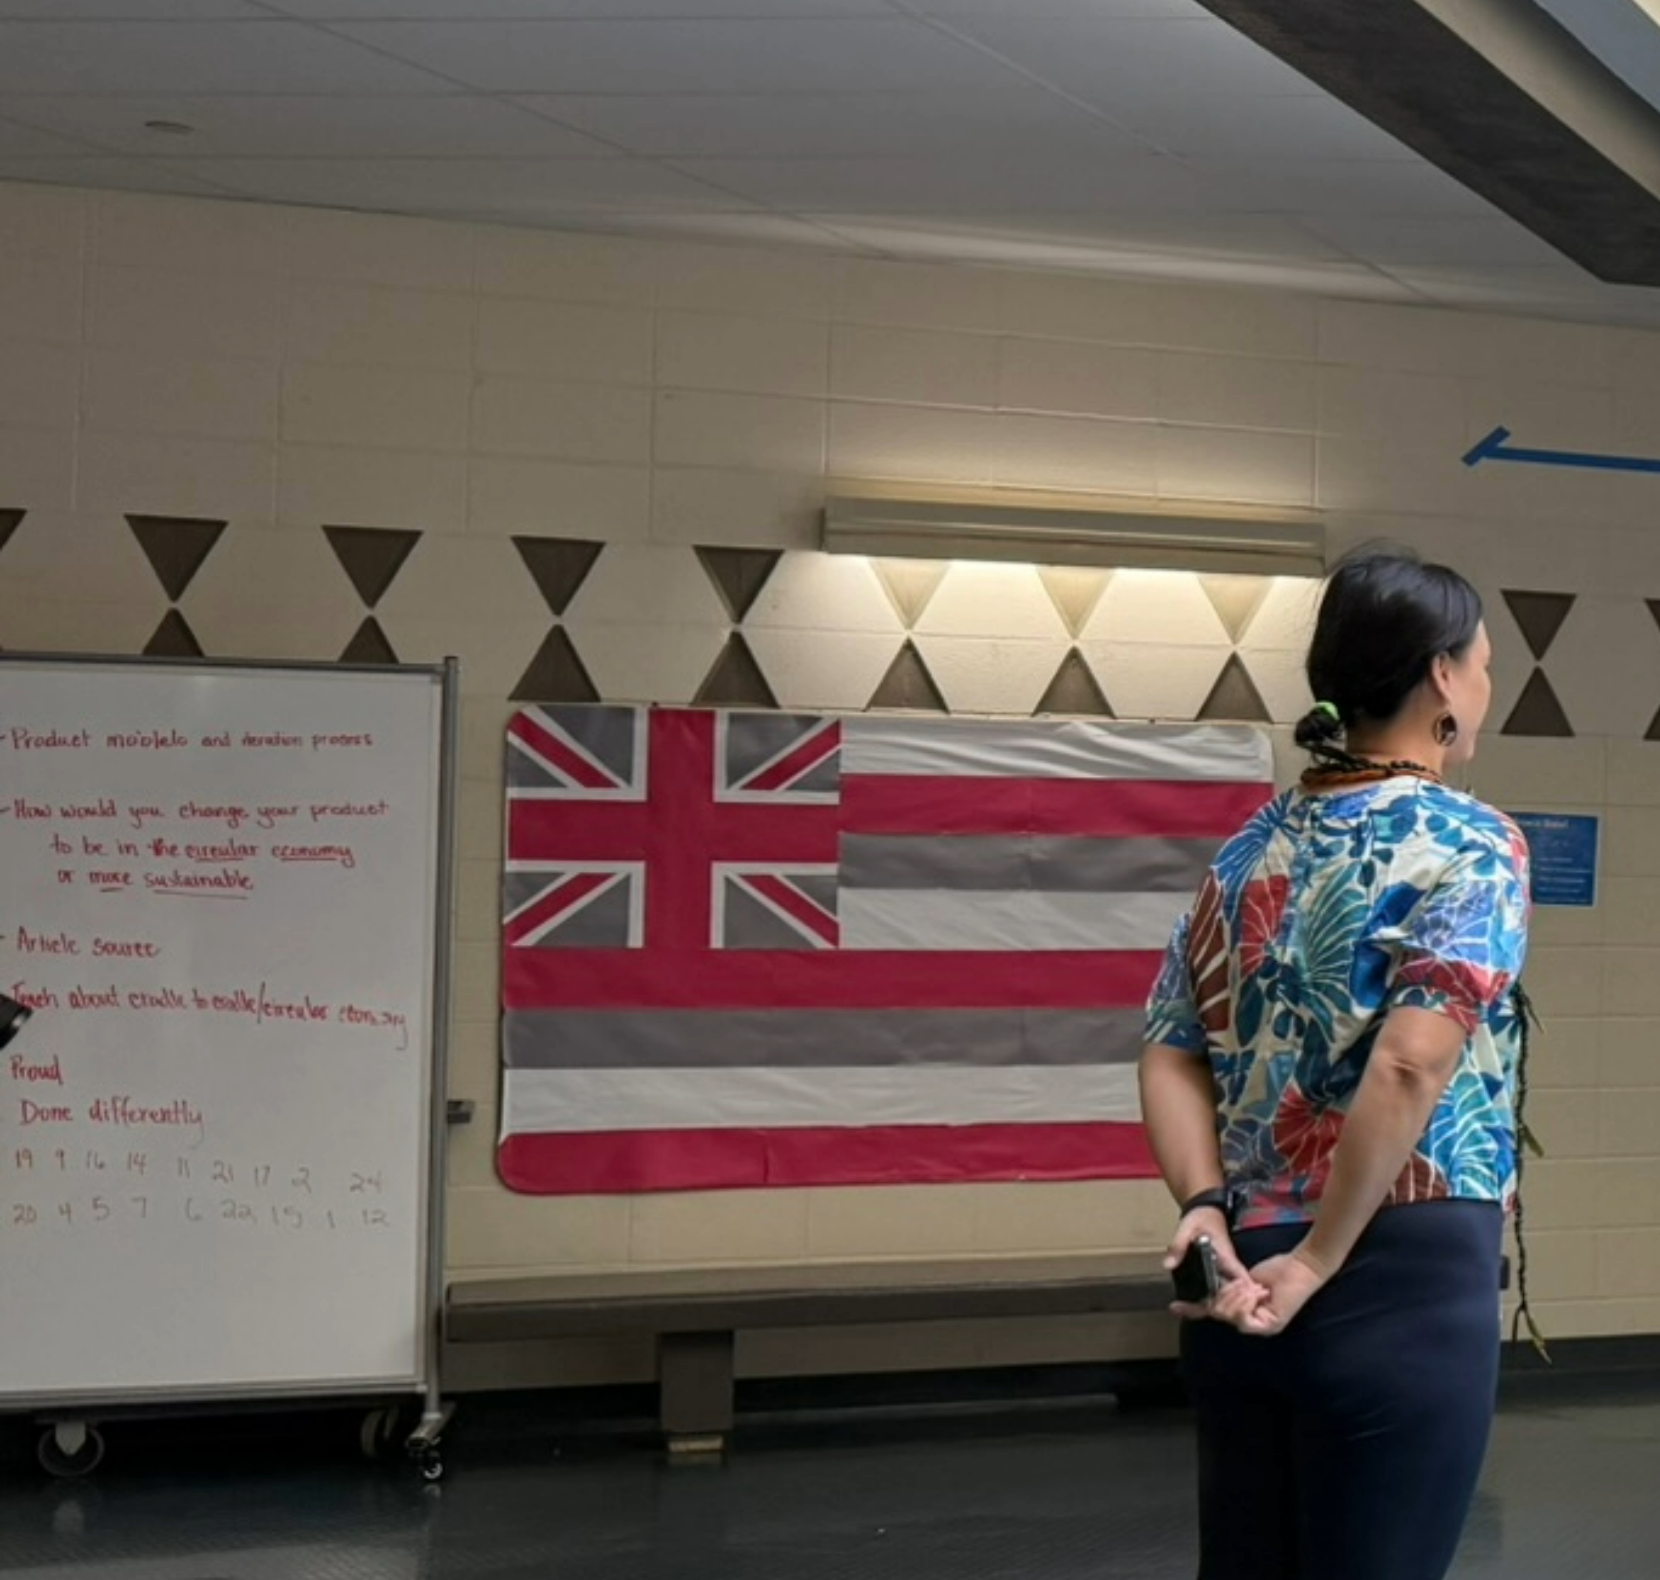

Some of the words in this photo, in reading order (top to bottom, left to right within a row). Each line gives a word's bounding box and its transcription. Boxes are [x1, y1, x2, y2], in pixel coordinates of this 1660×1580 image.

[201, 732, 231, 748] and
[311, 732, 374, 751] process
[60, 797, 117, 819] would
[128, 805, 165, 829] you
[179, 801, 250, 830] change
[256, 805, 300, 830] your
[309, 798, 389, 822] product
[49, 832, 73, 855] to
[82, 834, 109, 856] be
[116, 837, 140, 857] in
[147, 836, 181, 858] the
[185, 837, 260, 861] circular
[272, 842, 355, 869] economy
[57, 868, 75, 884] or
[88, 870, 134, 887] more
[143, 868, 254, 891] sustainable
[17, 925, 81, 956] Article
[68, 984, 121, 1011] about
[10, 1054, 64, 1085] Proud
[19, 1097, 74, 1125] Done
[88, 1095, 206, 1148] differently
[14, 1146, 34, 1170] 19
[253, 1164, 272, 1189] 17
[12, 1203, 38, 1226] 20
[57, 1201, 73, 1225] 4
[91, 1194, 111, 1222] 5
[131, 1194, 148, 1219] 7
